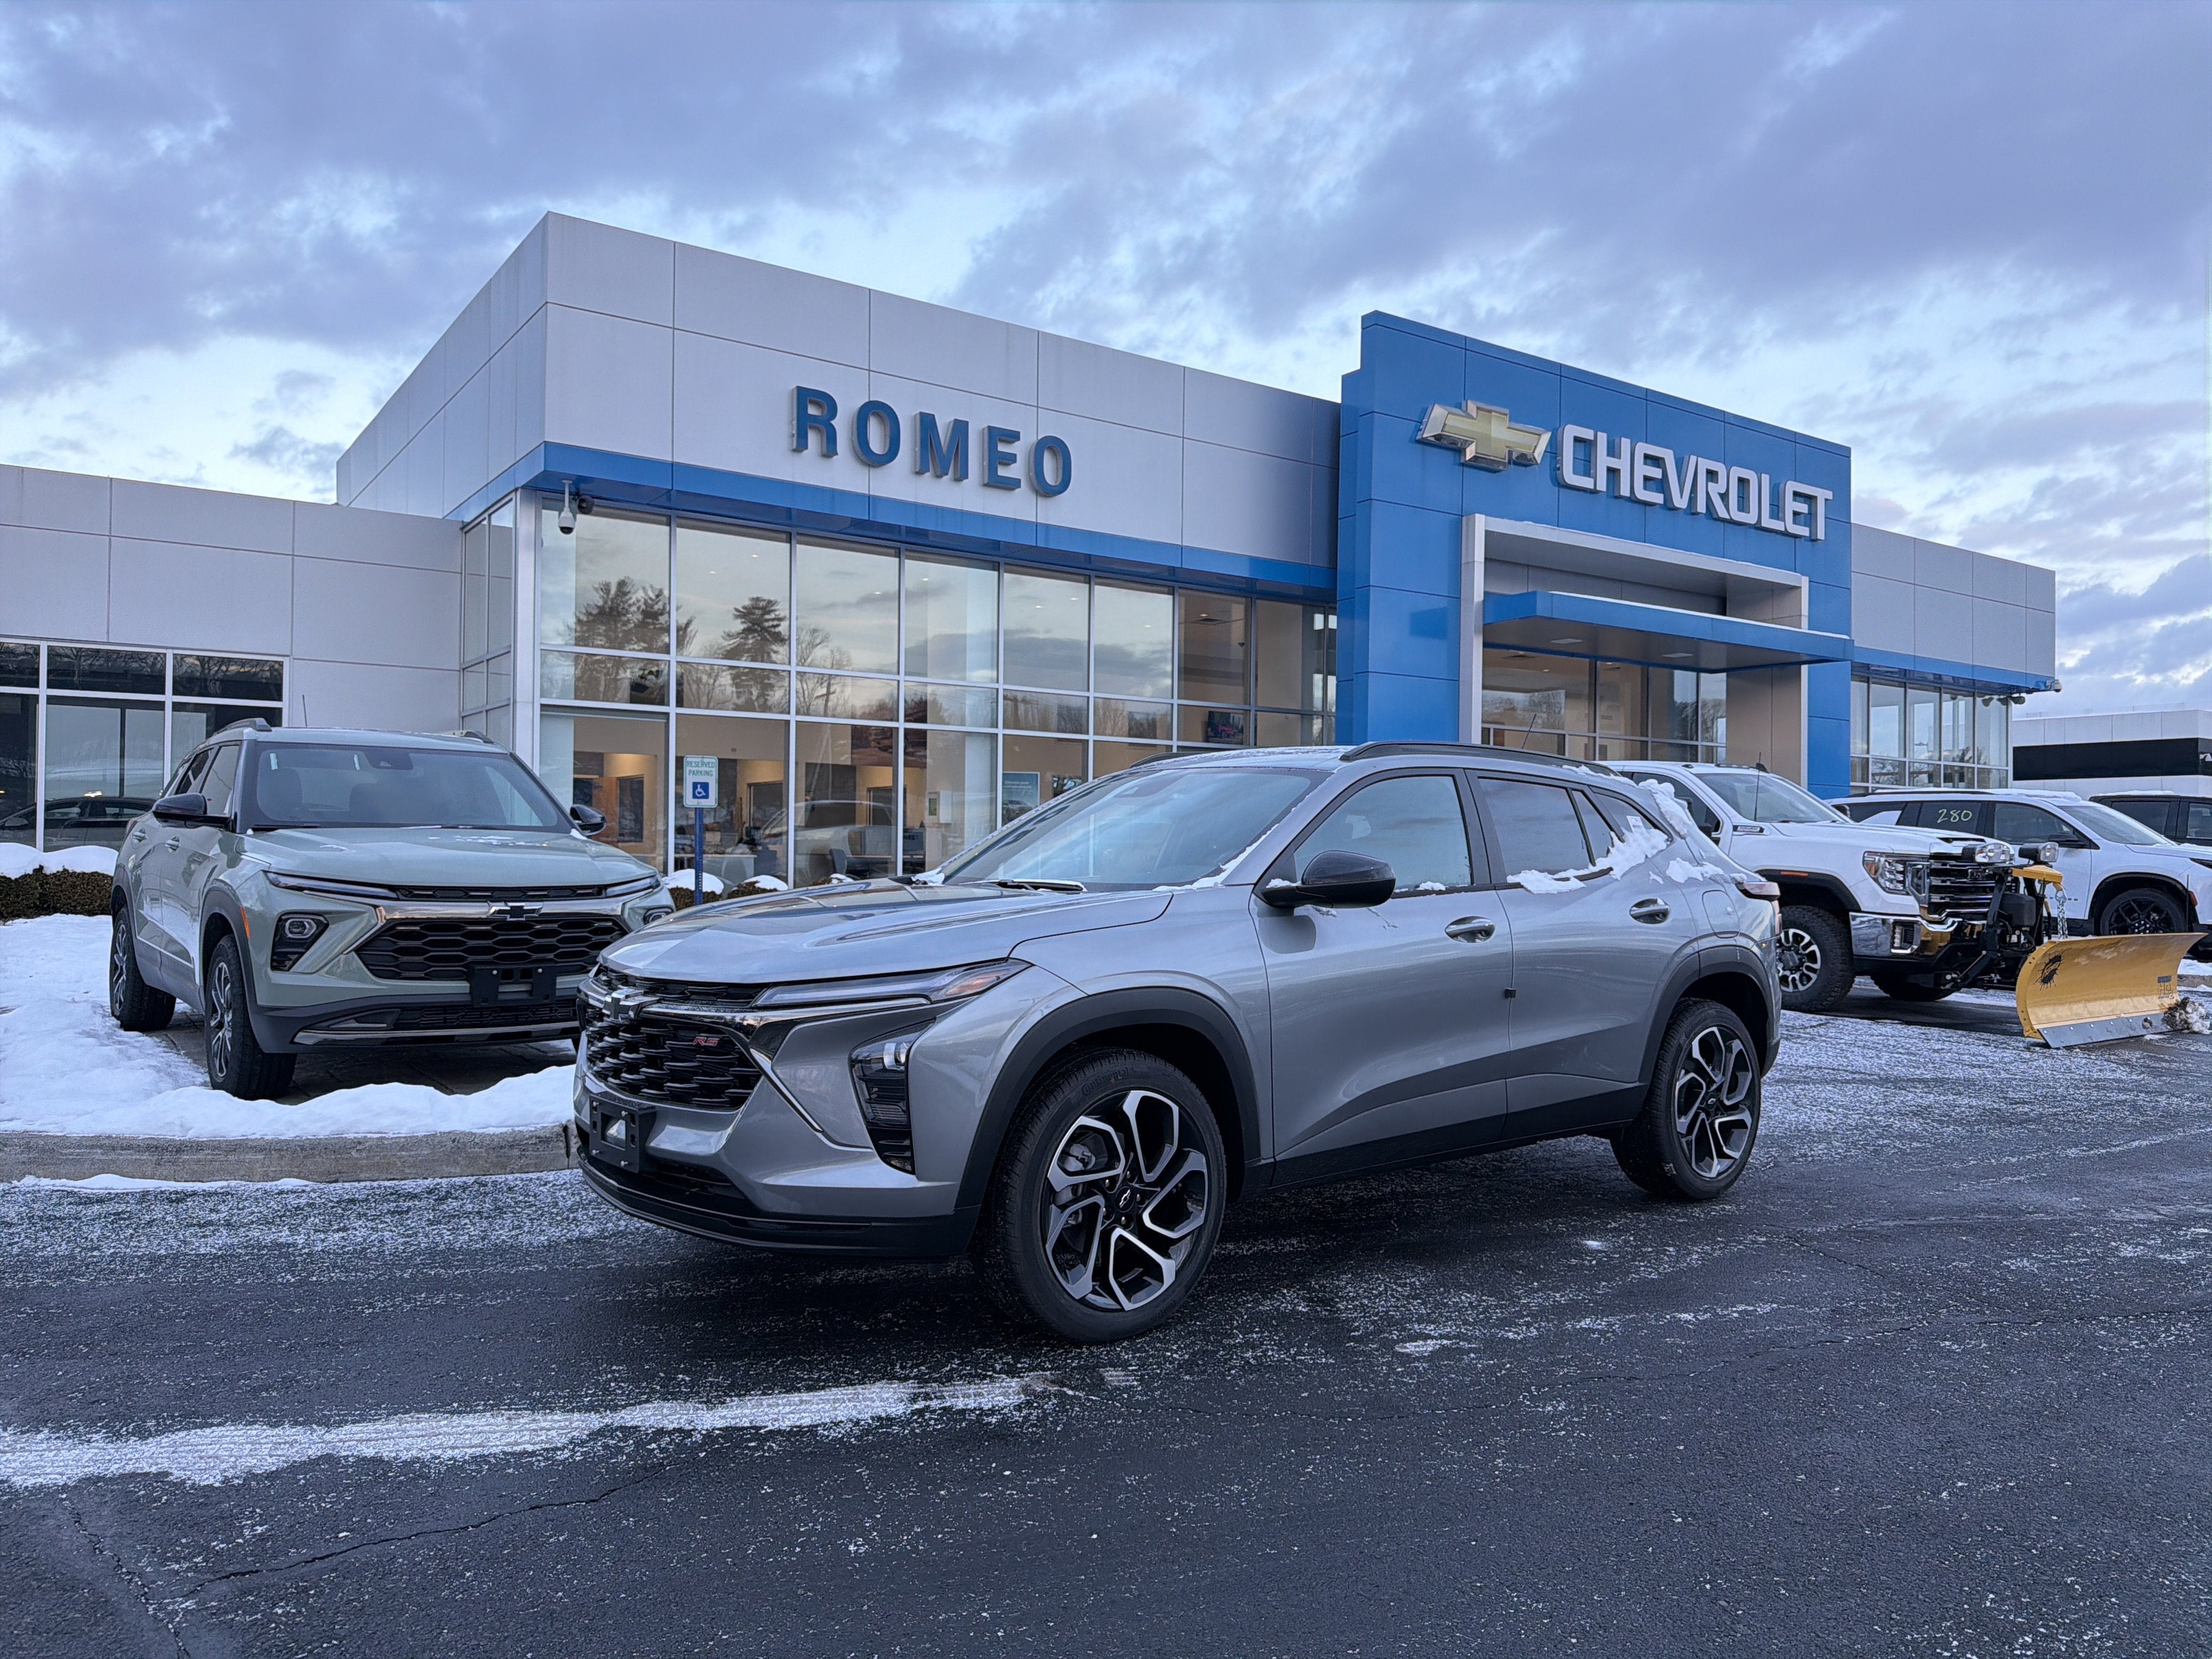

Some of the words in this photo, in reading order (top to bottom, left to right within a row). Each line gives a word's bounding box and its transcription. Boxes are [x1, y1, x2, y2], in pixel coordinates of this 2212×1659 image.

[792, 385, 1072, 497] ROMEO
[1556, 424, 1833, 541] CHEVROLET
[1937, 809, 1972, 823] 280
[693, 1036, 720, 1047] RS
